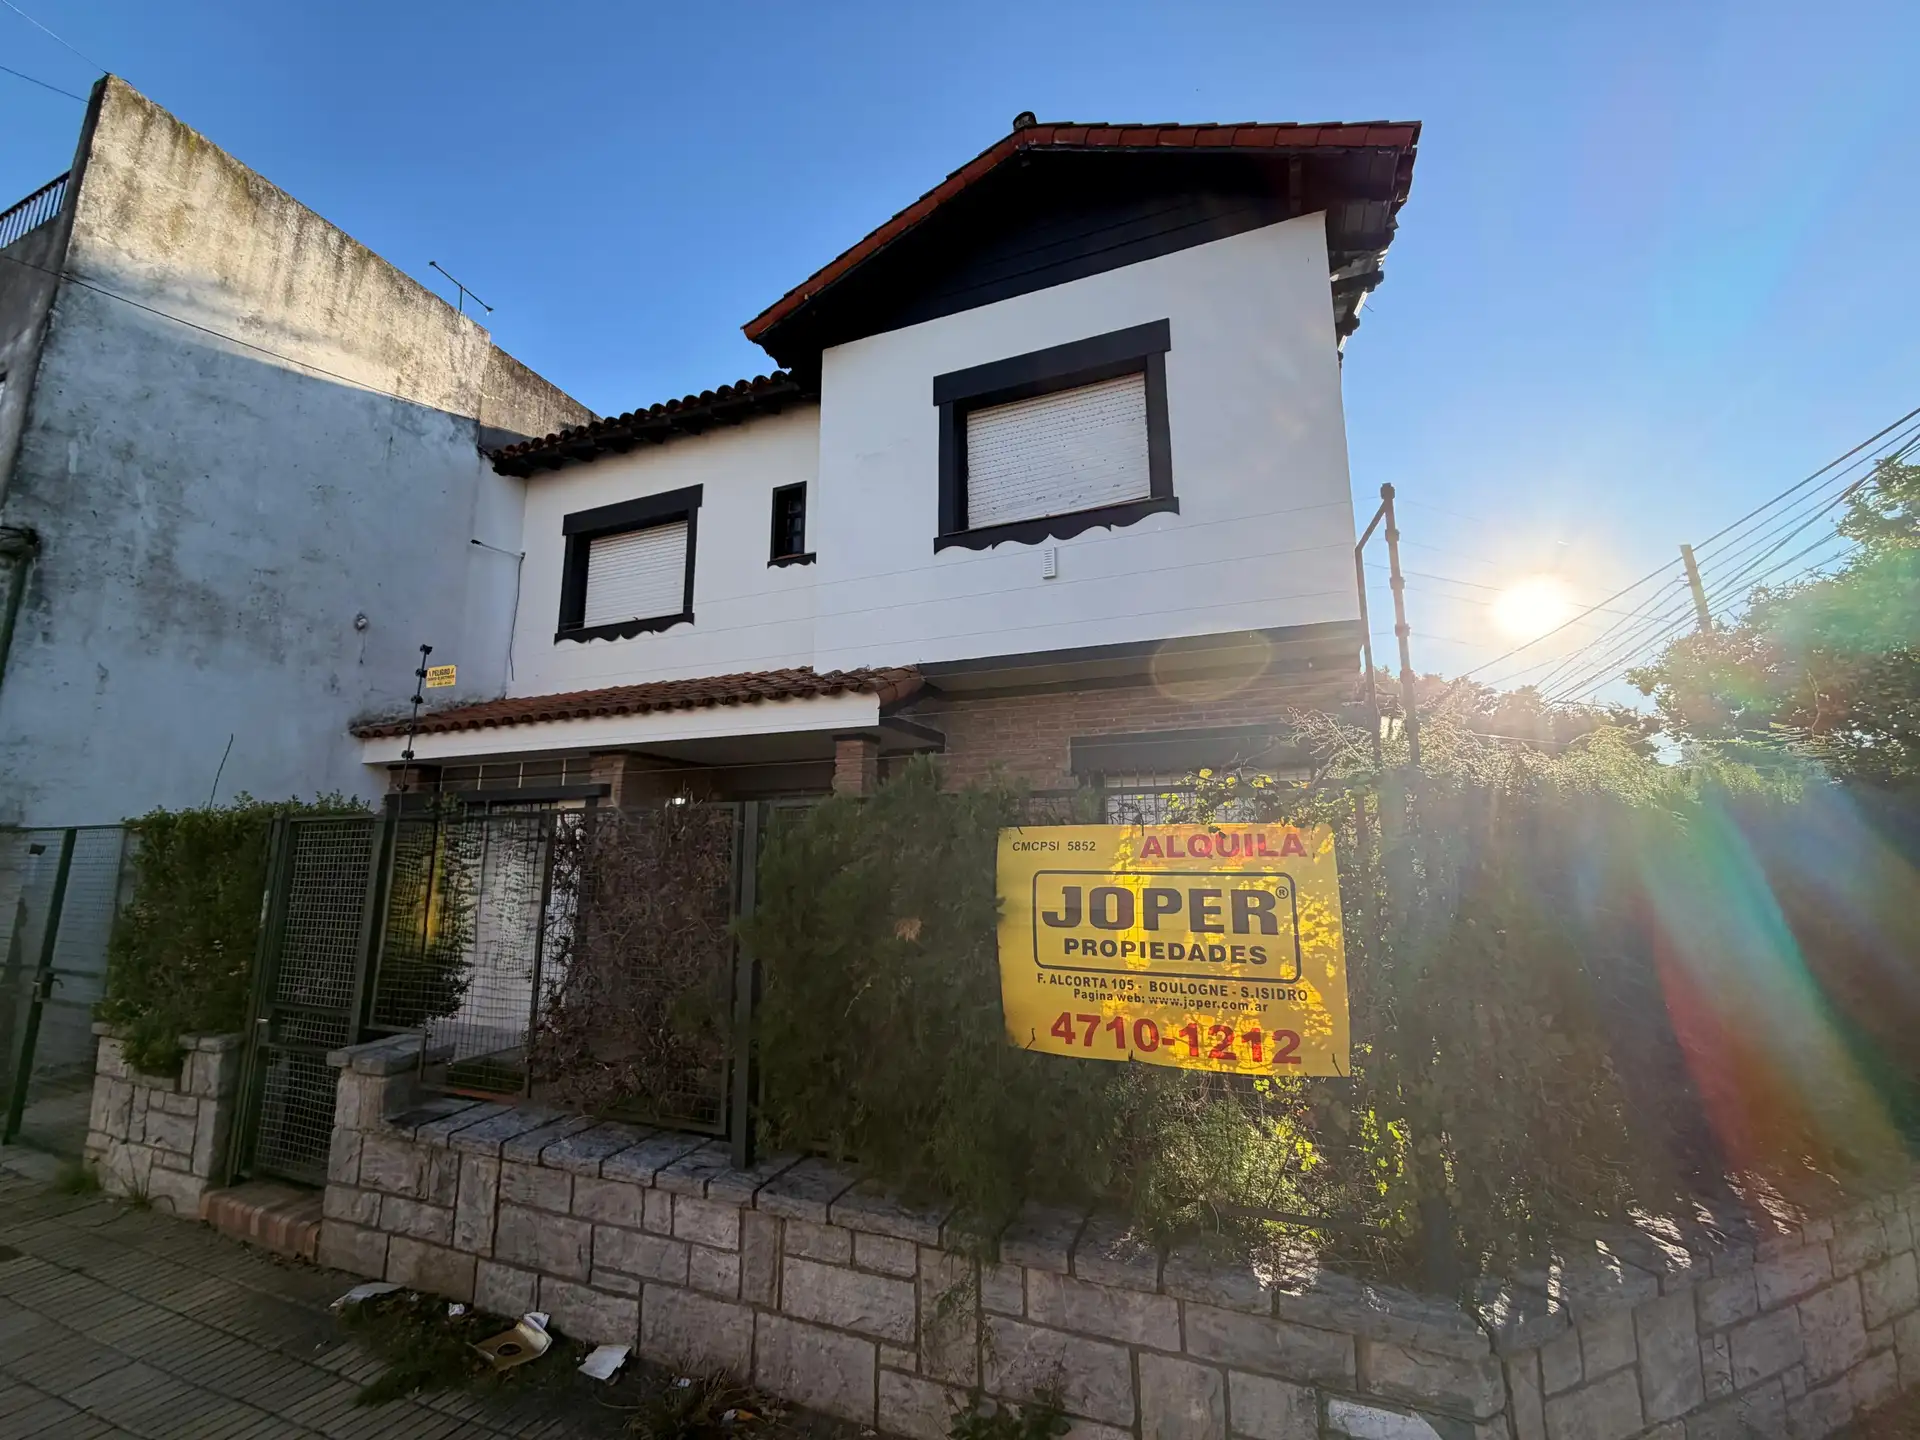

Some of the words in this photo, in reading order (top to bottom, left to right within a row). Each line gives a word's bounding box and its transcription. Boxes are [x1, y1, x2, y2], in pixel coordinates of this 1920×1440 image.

[1012, 841, 1060, 851] CMCPSI
[1067, 841, 1096, 851] 5852
[1140, 833, 1308, 859] ALQUILA
[1064, 938, 1268, 965] PROPIEDADES
[1037, 973, 1046, 984] F.
[1049, 974, 1108, 989] ALCORTA
[1111, 978, 1134, 991] 105
[1149, 981, 1229, 997] BOULOGNE
[1240, 986, 1308, 1002] S.ISIDRO
[1073, 988, 1113, 1002] Pagina
[1116, 992, 1145, 1004] web:
[1148, 996, 1268, 1012] www.joper.com.ar
[1050, 1011, 1302, 1065] 4710-1212
